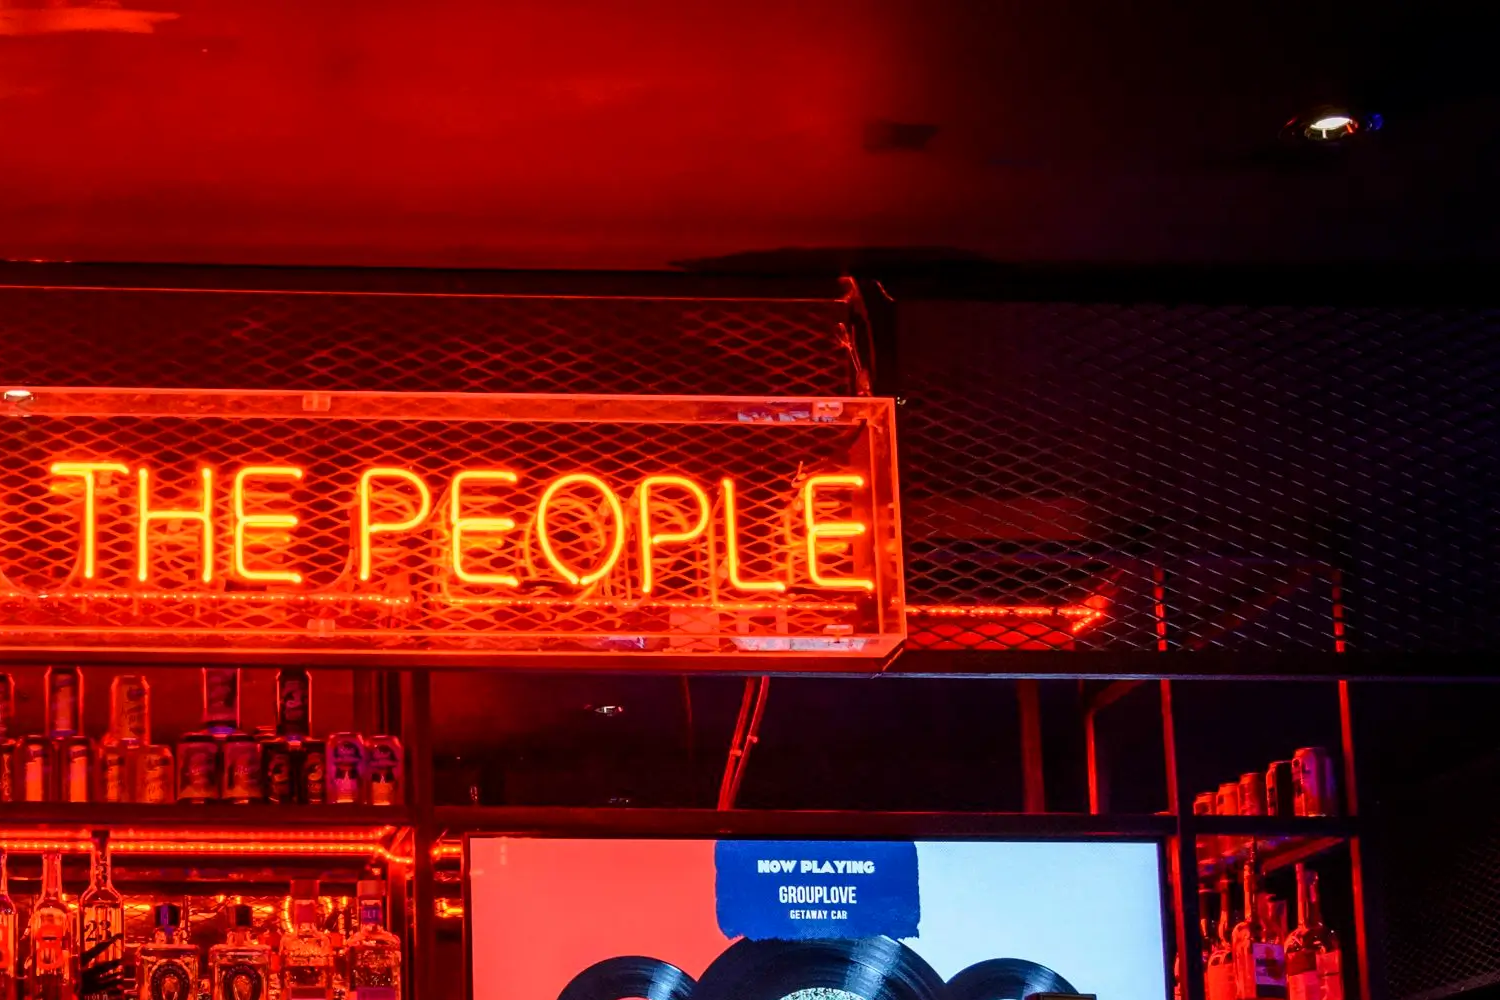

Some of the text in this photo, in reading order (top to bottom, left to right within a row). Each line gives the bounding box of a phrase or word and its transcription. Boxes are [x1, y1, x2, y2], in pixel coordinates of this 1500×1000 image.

[51, 462, 303, 584] THE
[358, 466, 874, 593] PEOPLE
[757, 859, 876, 874] NOW PLAYING
[778, 886, 858, 905] GROUPLOVE
[789, 909, 848, 920] GETAWAY CAR
